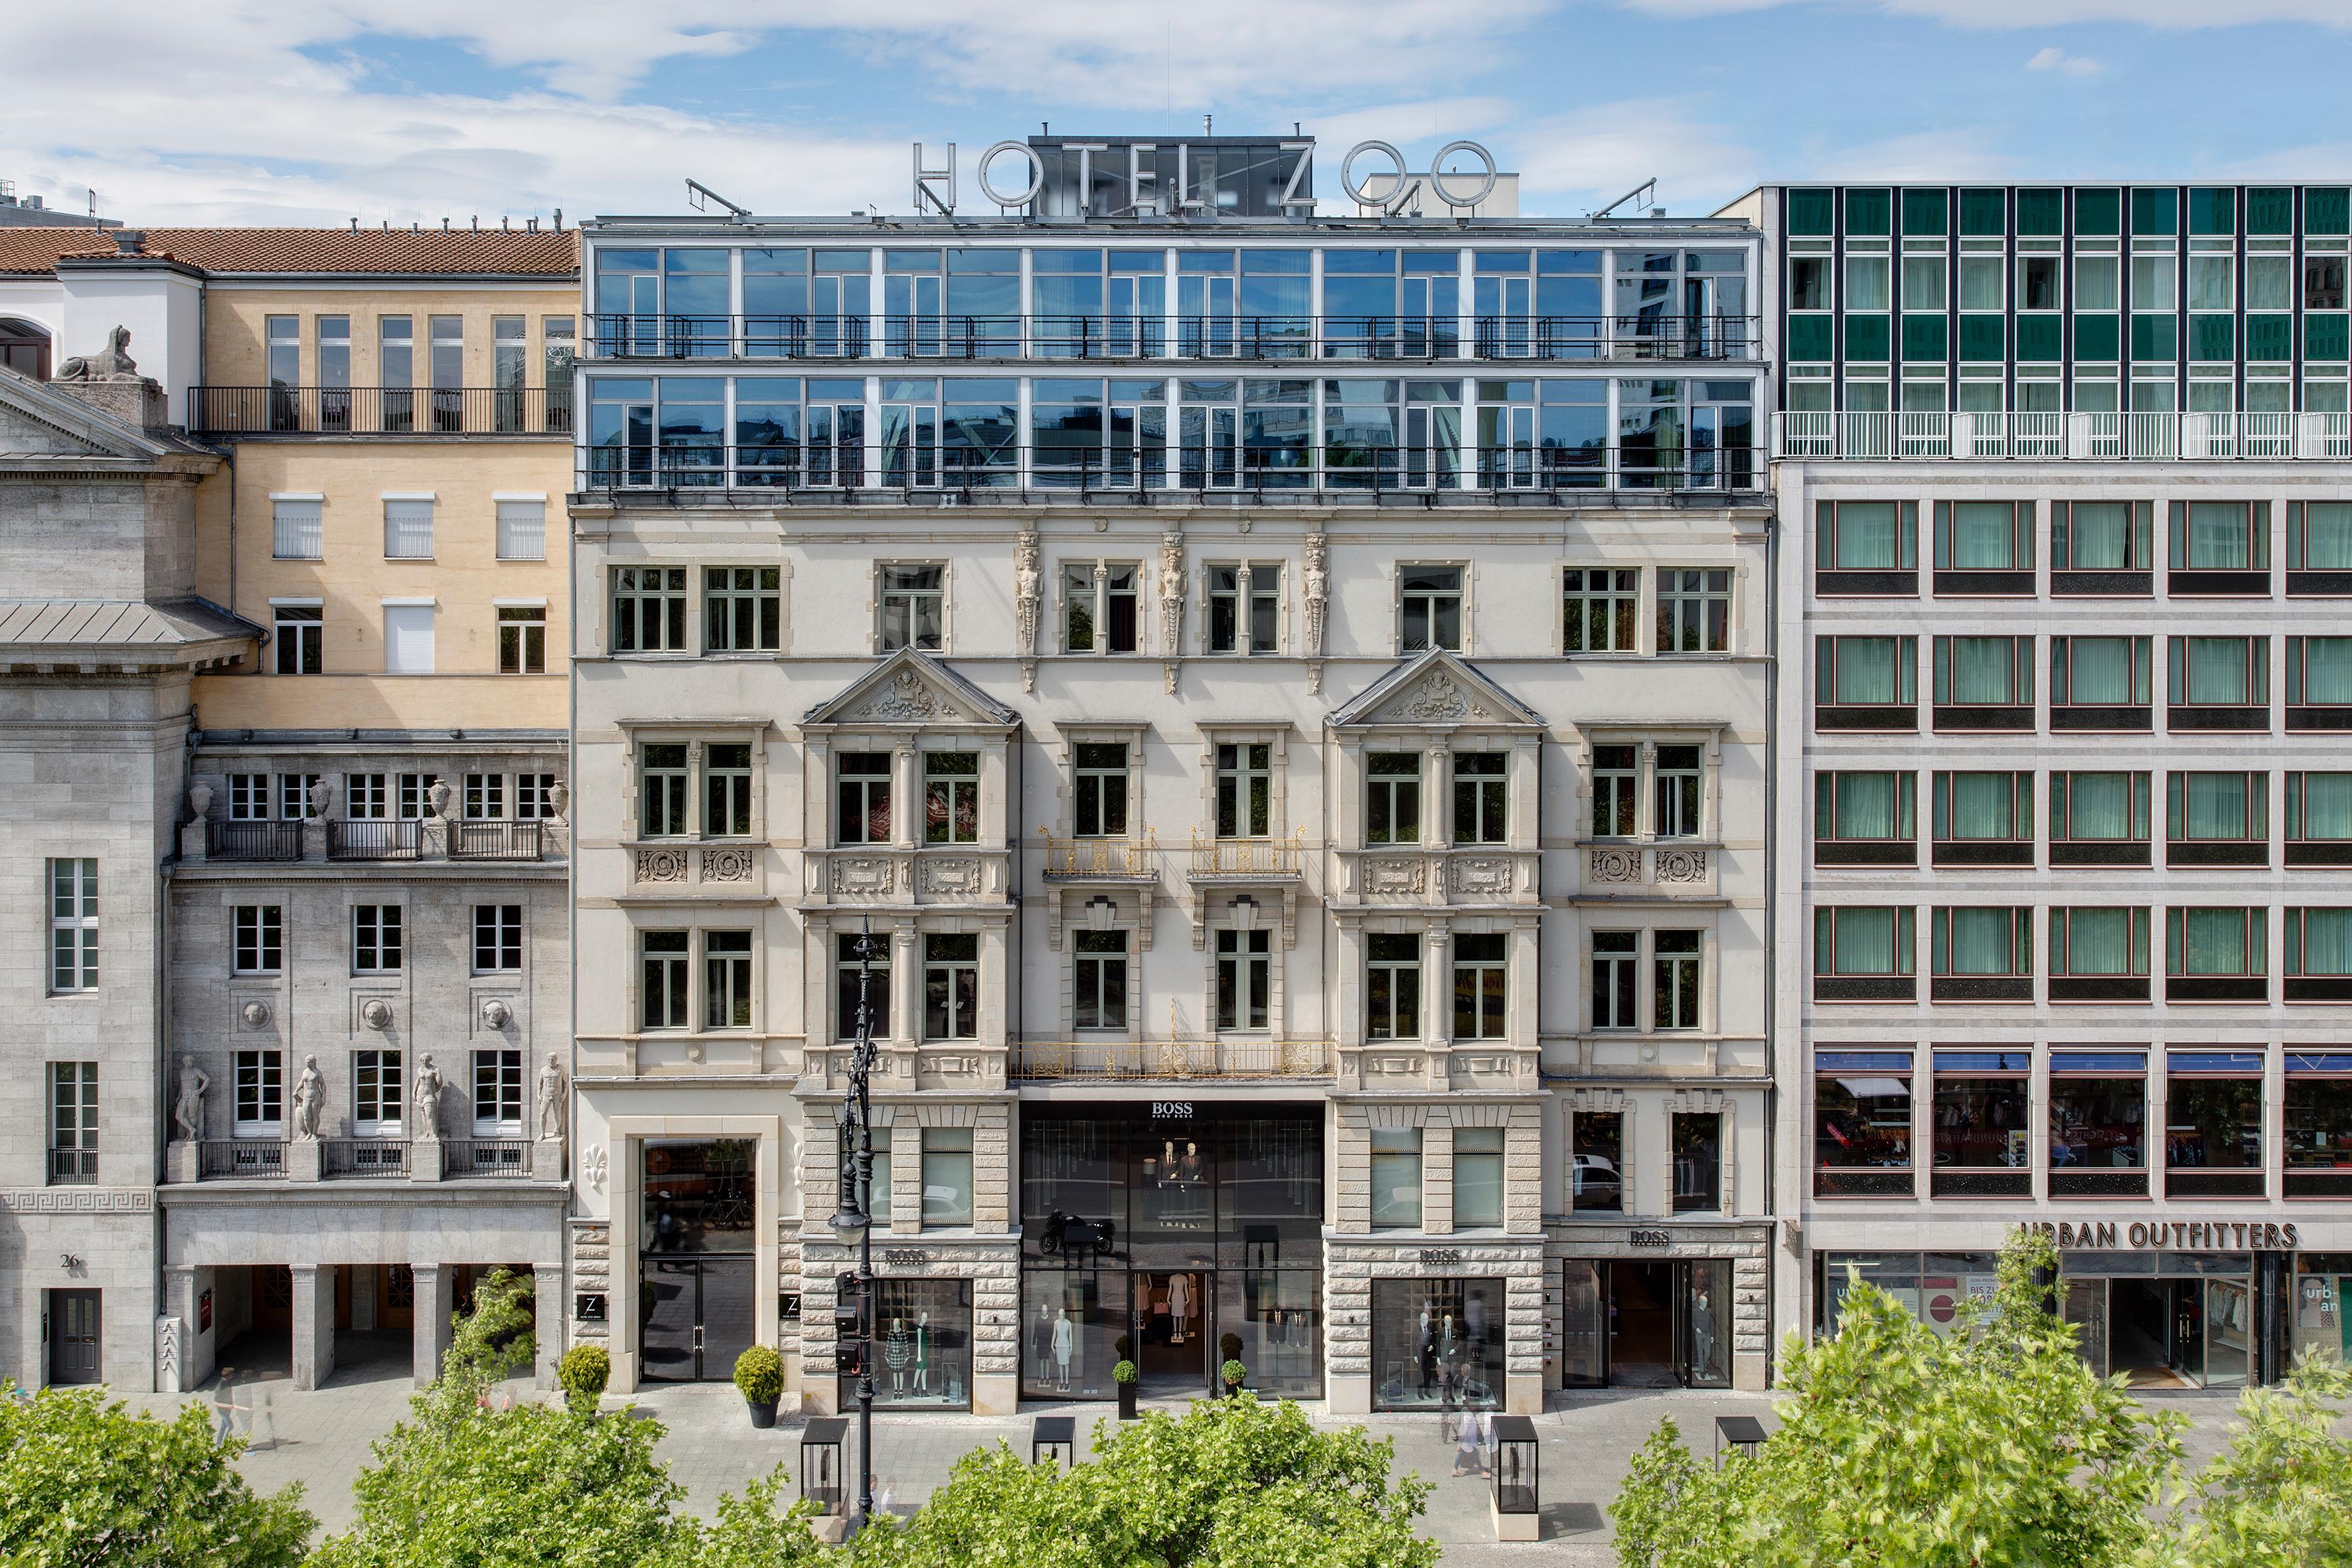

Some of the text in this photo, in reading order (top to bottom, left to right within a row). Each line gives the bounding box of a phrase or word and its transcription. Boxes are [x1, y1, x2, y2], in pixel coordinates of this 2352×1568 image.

[913, 140, 1496, 208] HOTEL ZOO
[1152, 1102, 1193, 1114] BOSS
[1630, 1231, 1670, 1243] BOSS
[2128, 1223, 2297, 1247] OUTFITTERS
[60, 1254, 80, 1268] 26
[886, 1249, 925, 1261] BOSS
[1420, 1249, 1459, 1261] BOSS
[2306, 1285, 2338, 1298] urb-
[2321, 1302, 2338, 1312] an
